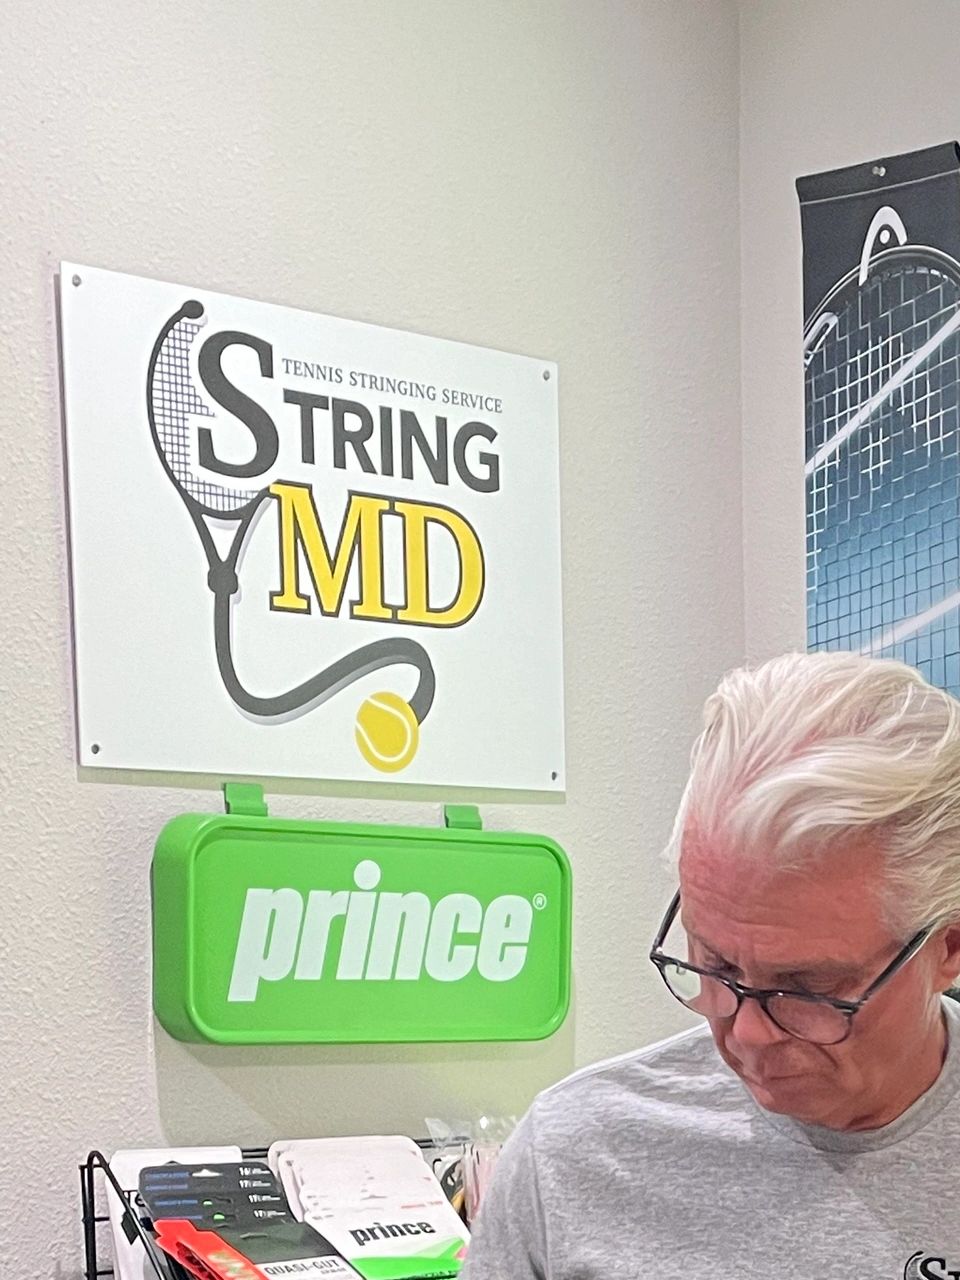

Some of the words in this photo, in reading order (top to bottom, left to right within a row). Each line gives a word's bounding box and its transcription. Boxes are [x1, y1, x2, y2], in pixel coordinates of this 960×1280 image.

[197, 330, 500, 493] STRING
[282, 358, 343, 384] TENNIS
[349, 371, 437, 401] STRINGING
[442, 388, 503, 414] SERVICE
[269, 479, 486, 628] MD
[350, 1222, 437, 1246] prince
[264, 1260, 340, 1275] QUASI-GUT
